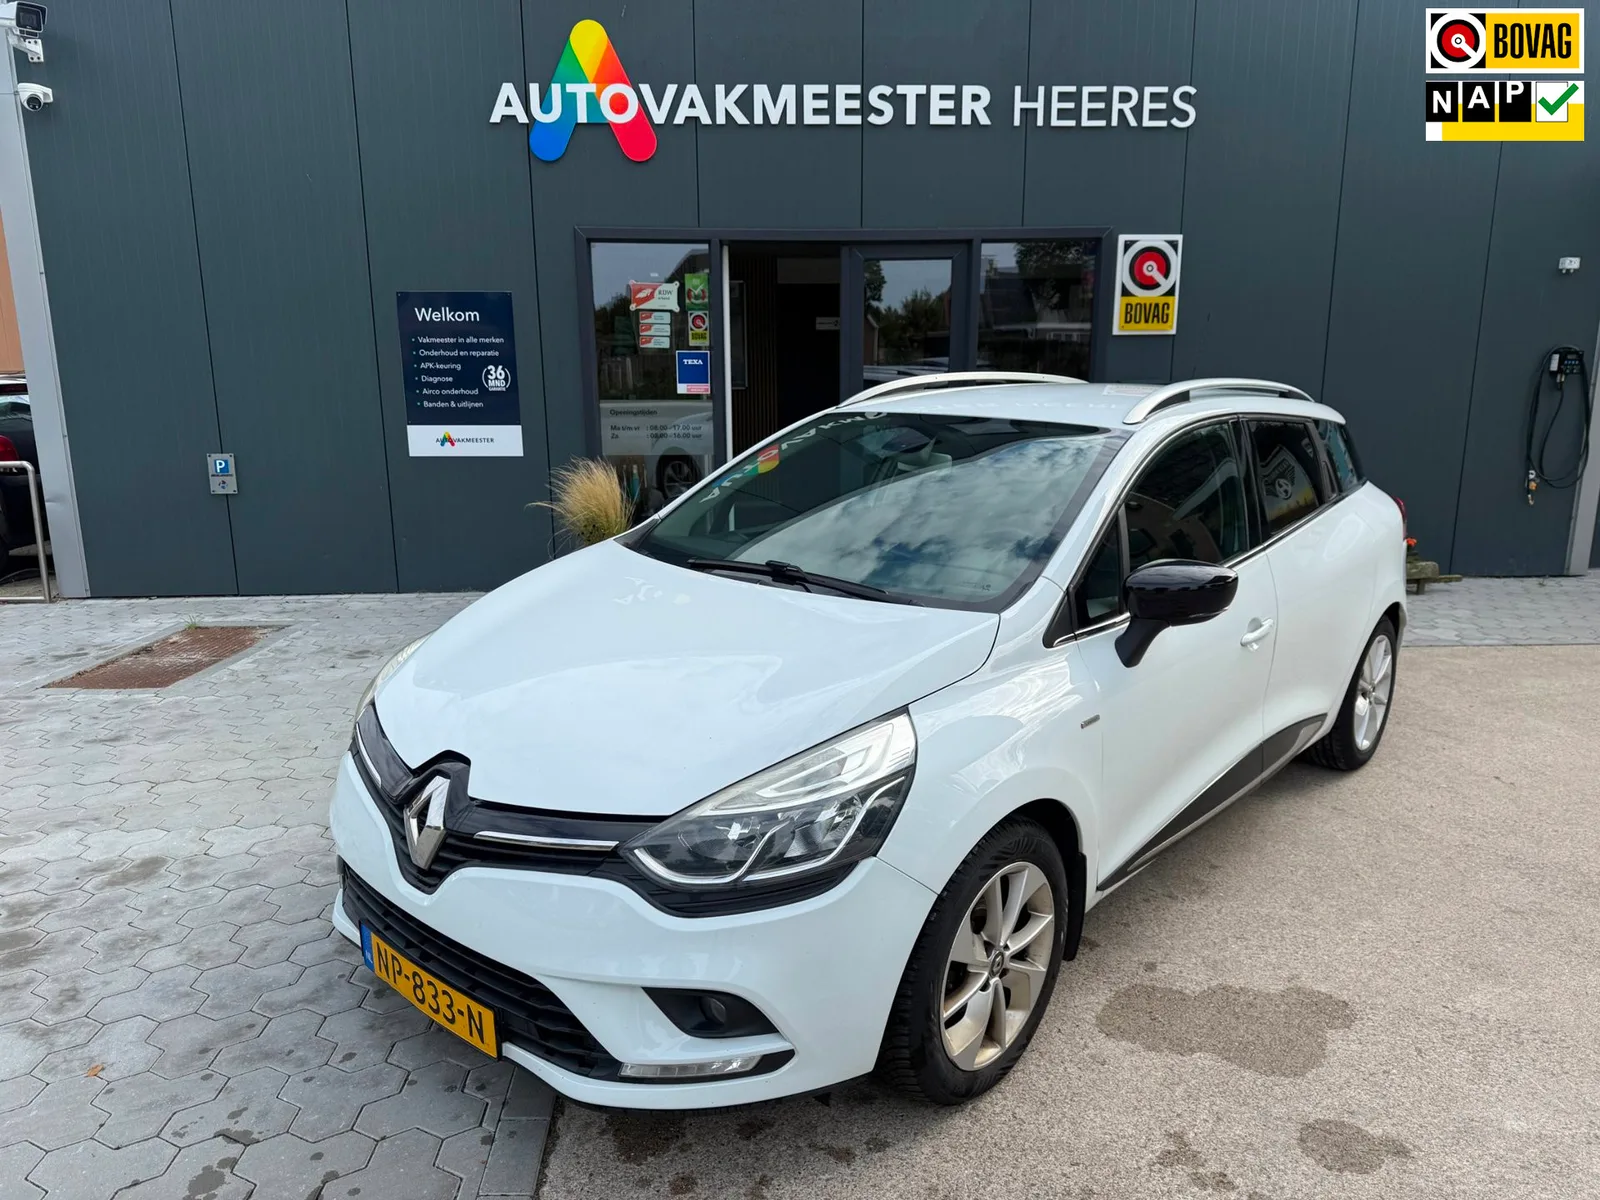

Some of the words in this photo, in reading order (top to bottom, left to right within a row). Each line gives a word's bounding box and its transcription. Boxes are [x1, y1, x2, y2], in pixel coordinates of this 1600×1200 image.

[488, 82, 992, 126] AUTOVAKMEESTER
[1011, 85, 1199, 129] HEERES
[414, 306, 480, 322] Welkom
[1124, 302, 1170, 324] BOVAG
[470, 350, 500, 358] reparatie
[420, 362, 462, 372] APK-keuring
[487, 364, 506, 380] 36
[421, 375, 454, 384] Diagnose
[488, 379, 506, 387] MND
[457, 400, 484, 409] uitlijnen
[216, 460, 226, 473] P
[376, 942, 485, 1045] NP-833-N
